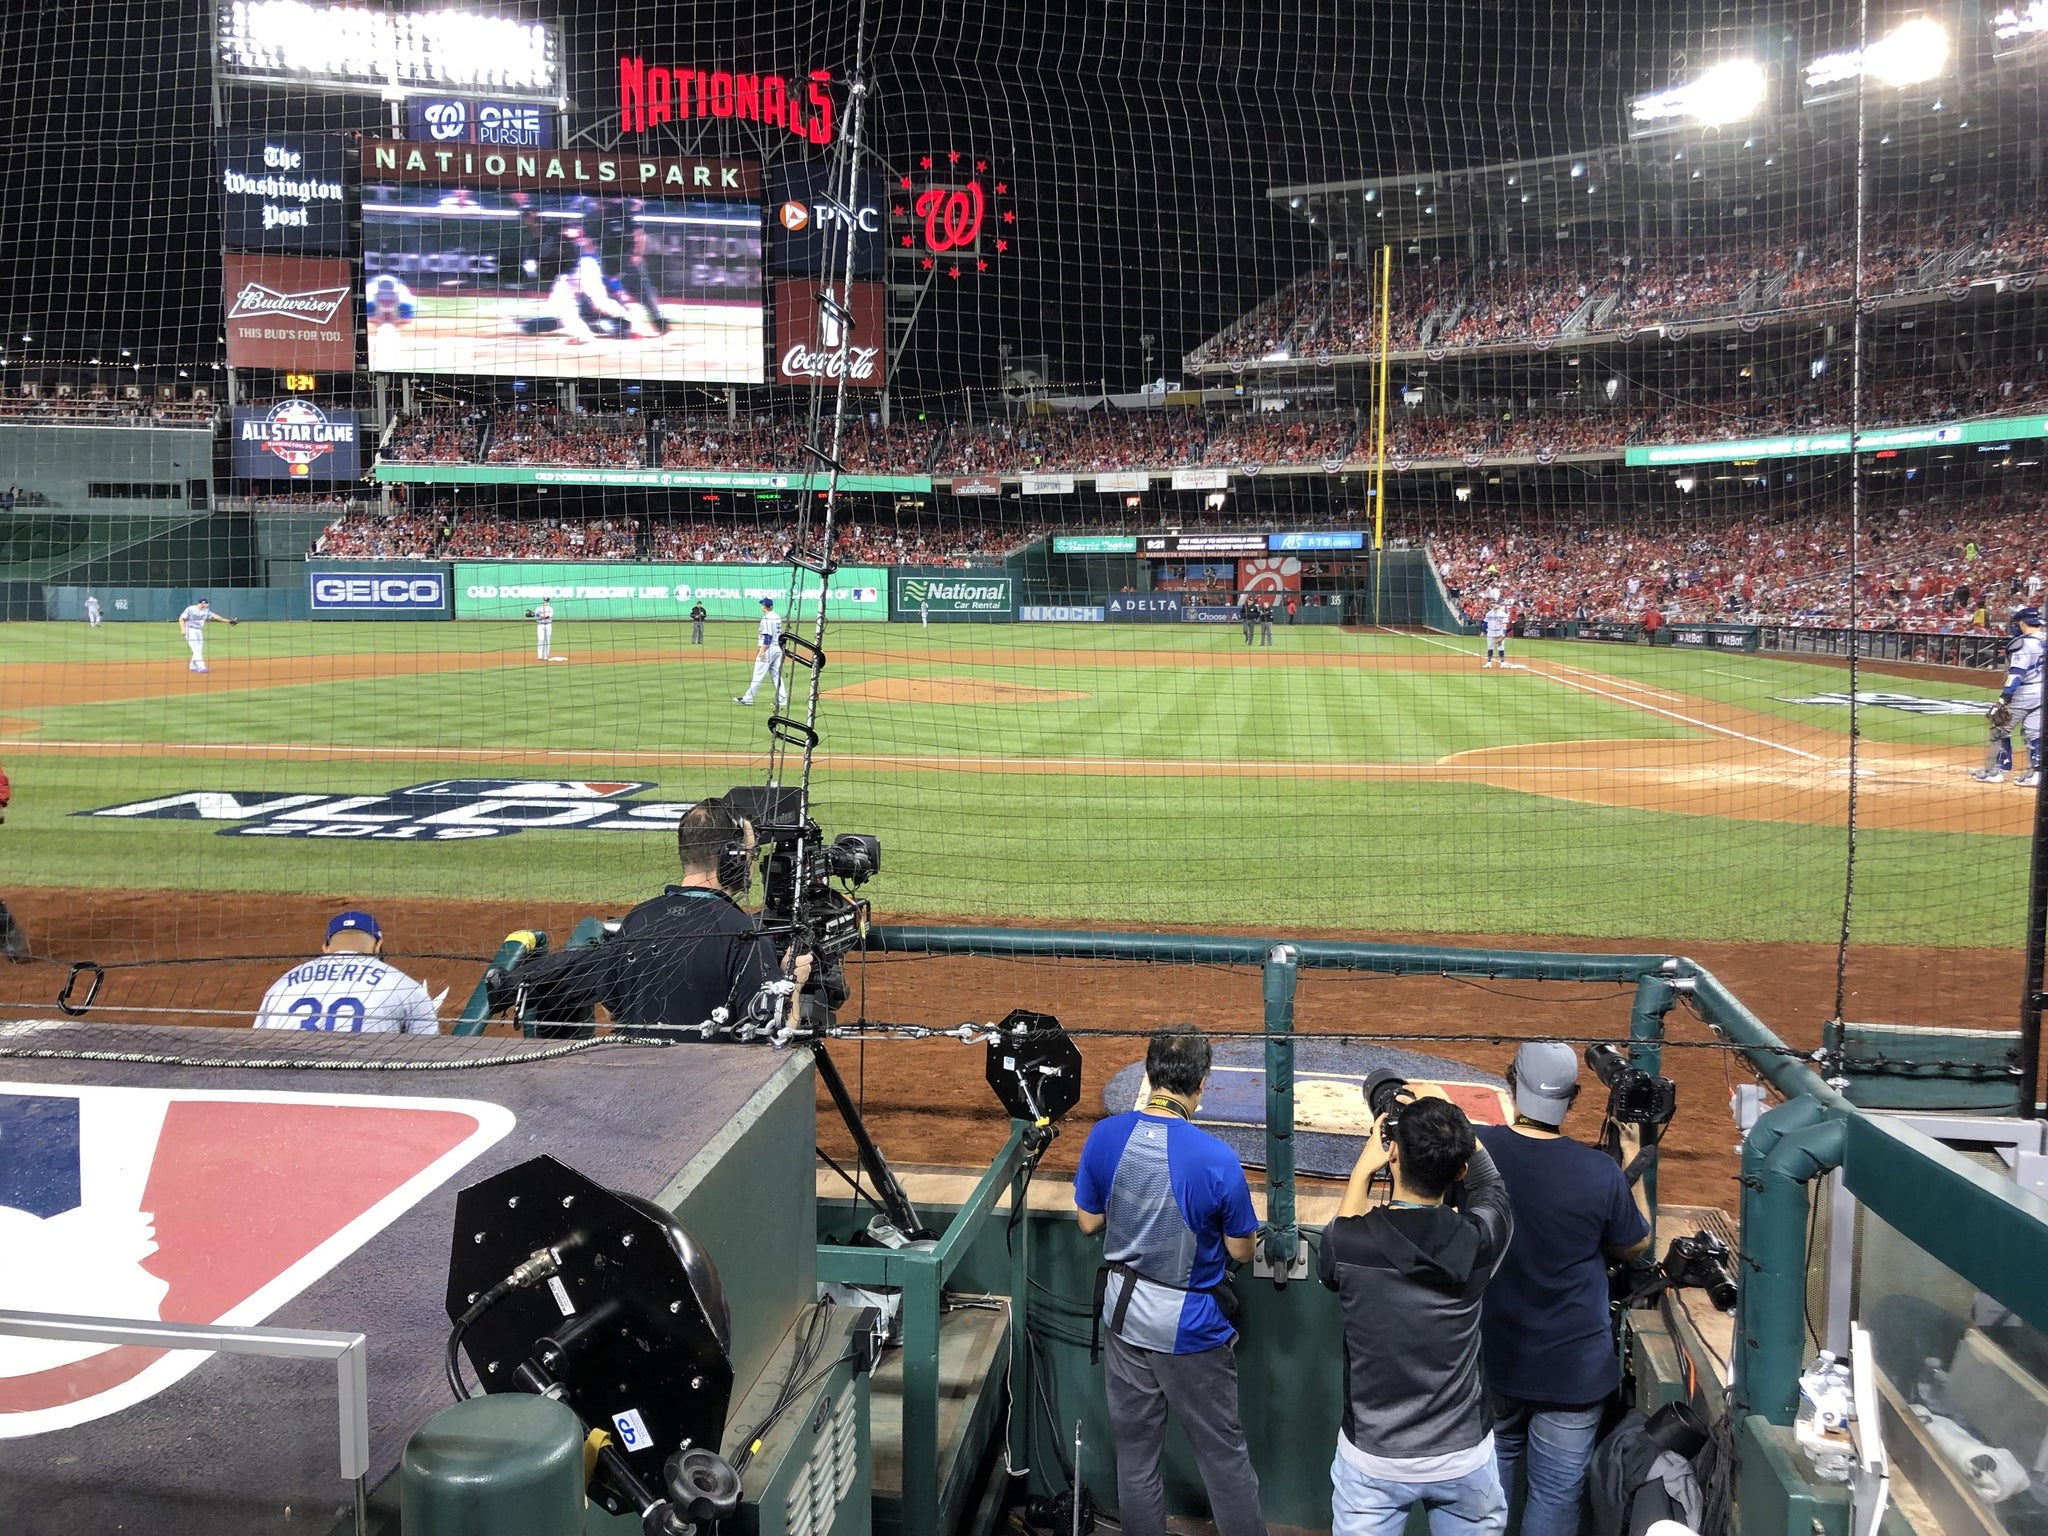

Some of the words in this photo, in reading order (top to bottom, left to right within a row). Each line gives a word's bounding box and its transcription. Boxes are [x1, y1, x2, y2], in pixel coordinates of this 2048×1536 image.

[619, 56, 832, 144] NATIONALS
[480, 106, 540, 130] ONE
[480, 128, 541, 146] PURSUIT
[264, 146, 301, 171] The
[375, 147, 617, 183] NATIONALS
[639, 163, 740, 188] PARK
[223, 169, 343, 203] Washington
[262, 204, 309, 231] Post
[812, 205, 879, 232] PNC
[237, 290, 339, 313] Budweiser
[238, 327, 262, 339] THIS
[264, 328, 296, 340] BUD'S
[298, 330, 317, 341] FOR
[320, 331, 344, 342] YOU.
[781, 344, 879, 380] Coca-Cola
[286, 375, 315, 391] 0:34
[242, 423, 270, 441] ALL
[271, 424, 311, 441] STAR
[313, 424, 354, 442] GAME
[1147, 540, 1165, 549] 9:21
[316, 580, 441, 603] GEICO
[695, 588, 741, 599] OFFICIAL
[835, 590, 850, 600] OF
[927, 583, 1003, 600] National
[1330, 595, 1341, 606] 335
[954, 601, 970, 609] Car
[971, 601, 1001, 609] Rental
[1041, 606, 1097, 621] KOCH
[1126, 600, 1178, 611] DELTA
[1198, 612, 1227, 620] Choose
[287, 963, 387, 988] ROBERTS
[288, 997, 366, 1033] 30
